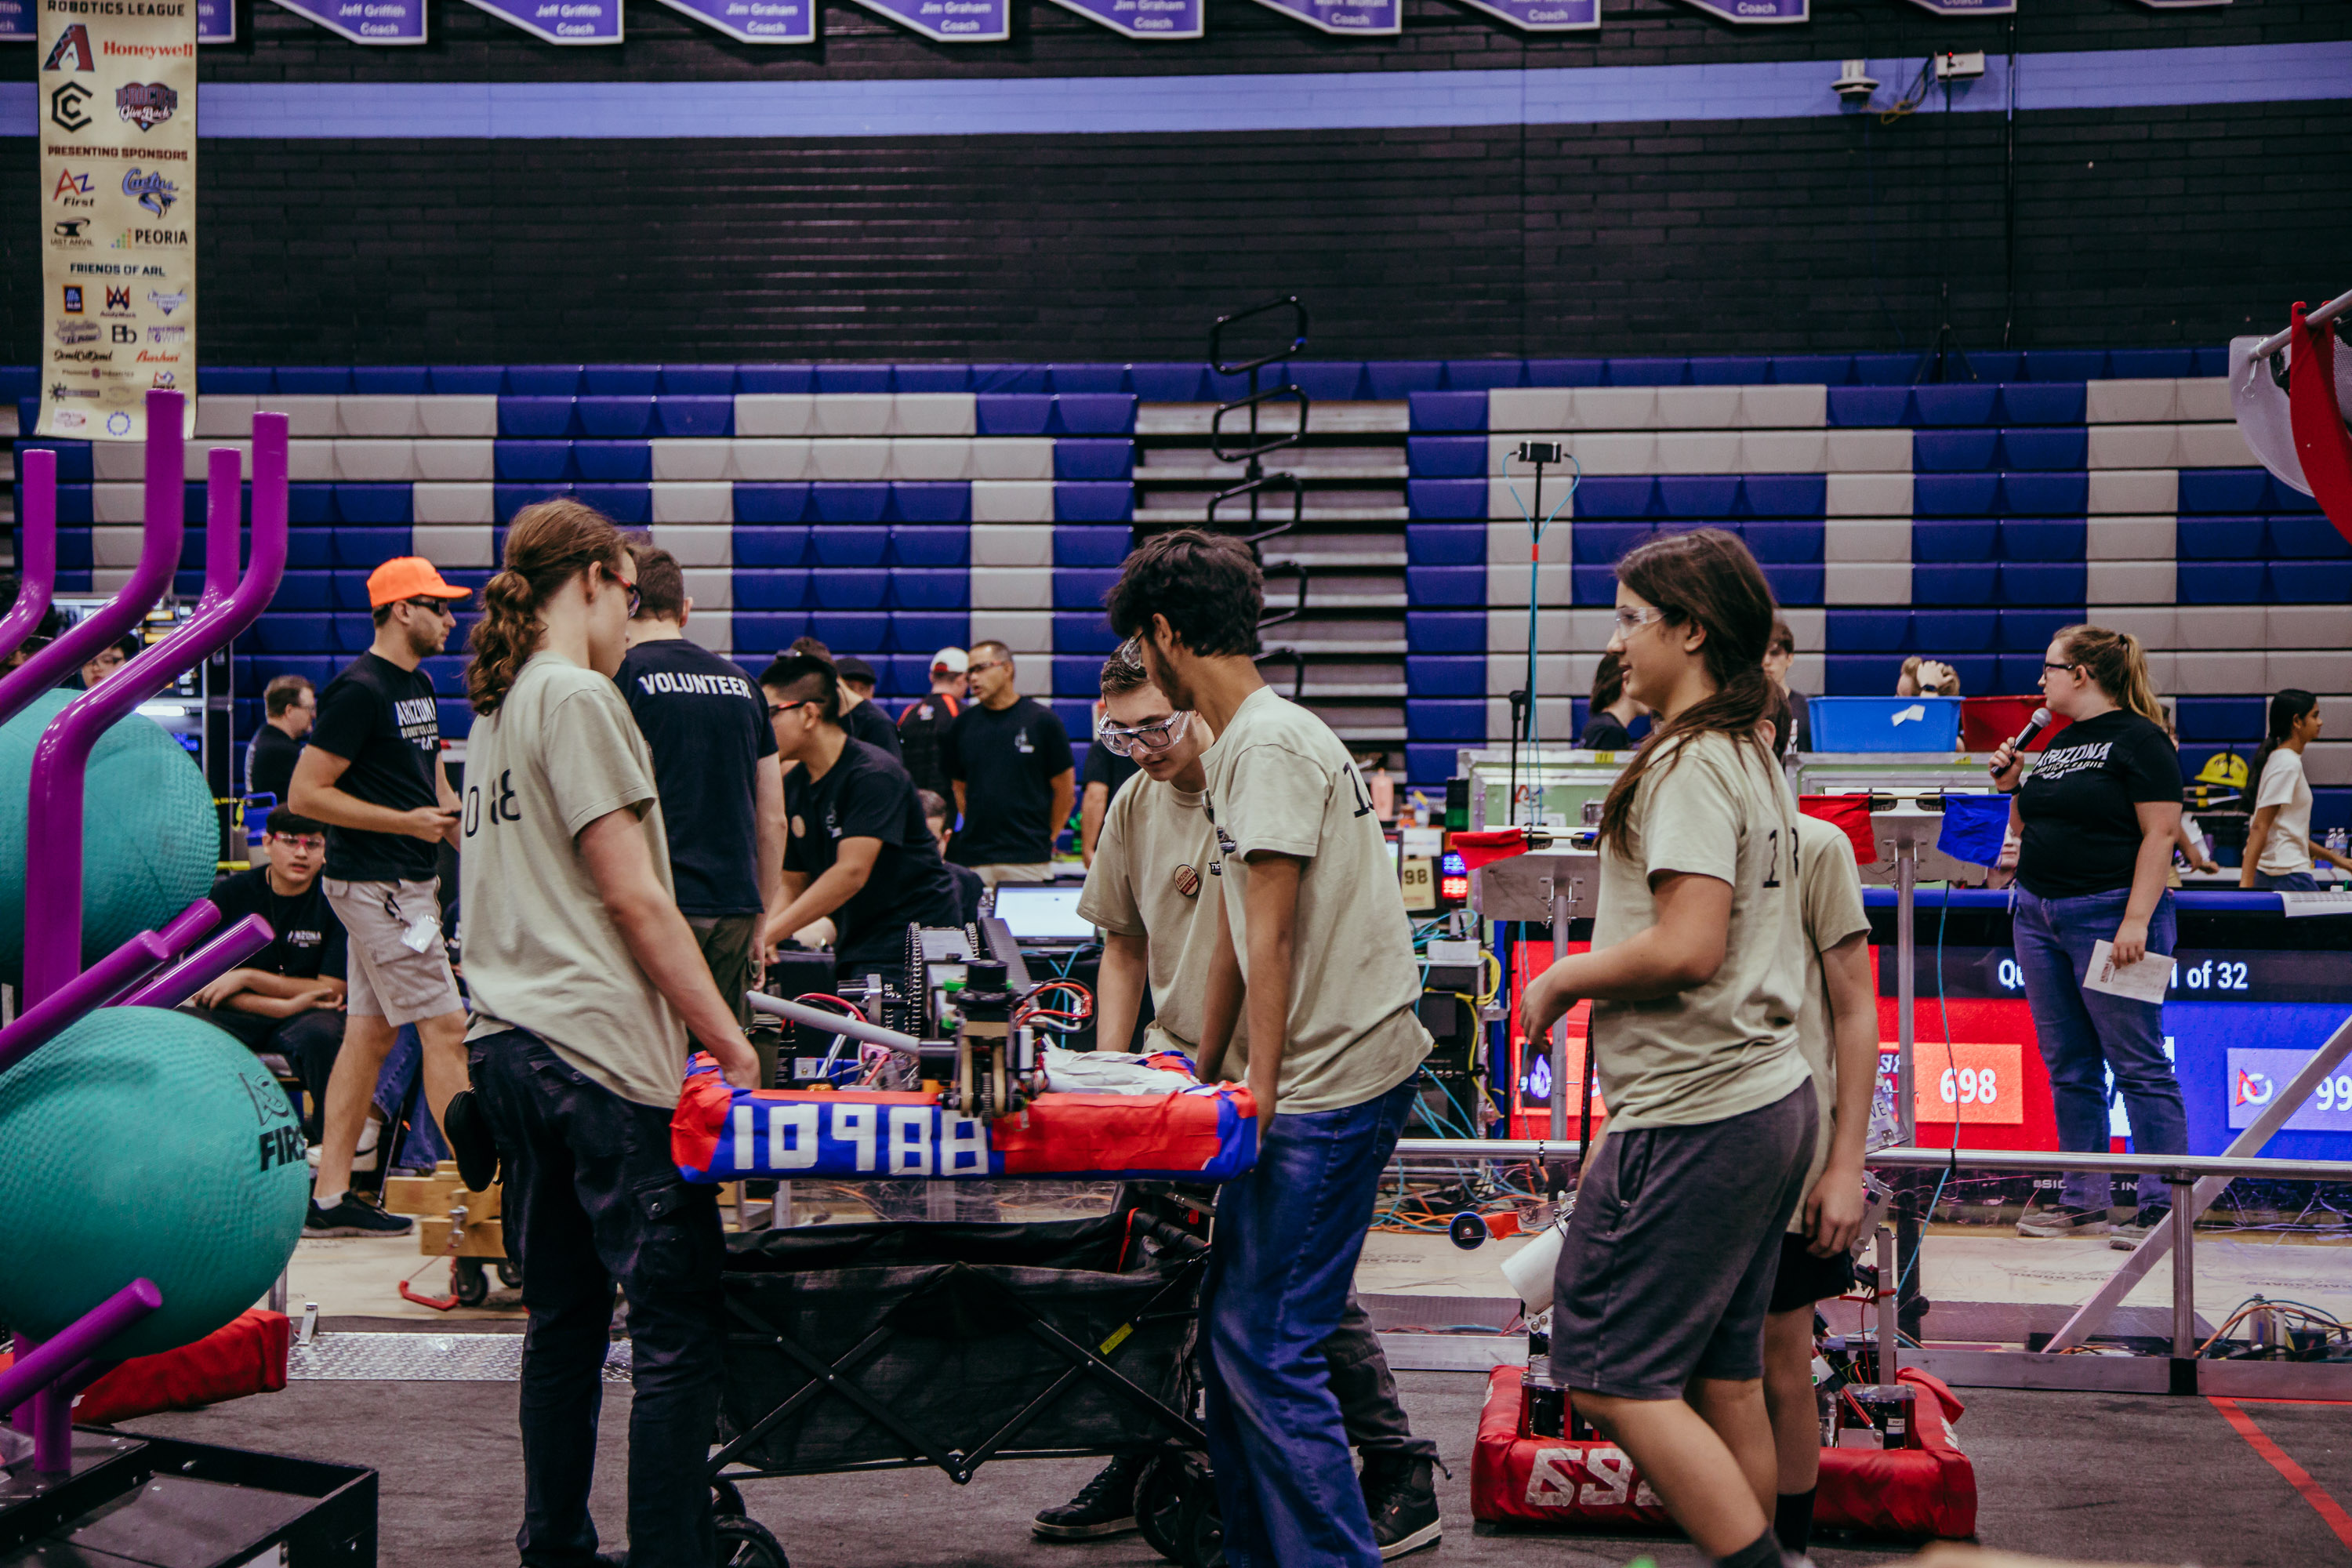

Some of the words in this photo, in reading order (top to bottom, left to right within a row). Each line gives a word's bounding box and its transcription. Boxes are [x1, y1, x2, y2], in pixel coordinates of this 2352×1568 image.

[48, 1, 124, 15] ROBOTICS
[128, 3, 185, 16] LEAGUE
[1528, 9, 1568, 21] Coach
[1737, 2, 1777, 14] Coach
[941, 20, 980, 32] Coach
[1134, 16, 1174, 29] Coach
[1331, 13, 1370, 26] Coach
[360, 22, 399, 35] Coach
[557, 22, 595, 35] Coach
[746, 20, 786, 34] Coach
[103, 41, 193, 60] Honeywell
[48, 146, 118, 157] PRESENTING
[122, 148, 188, 161] SPONSORS
[64, 196, 95, 207] First
[136, 228, 188, 245] PEORIA
[70, 263, 121, 275] FRIENDS
[124, 264, 139, 275] OF
[142, 266, 166, 277] ARL
[638, 672, 752, 699] VOLUNTEER
[2187, 960, 2212, 989] of
[2217, 961, 2249, 989] 32
[1940, 1068, 1997, 1104] 698
[734, 1103, 989, 1176] 10988
[1525, 1448, 1663, 1507] 69
